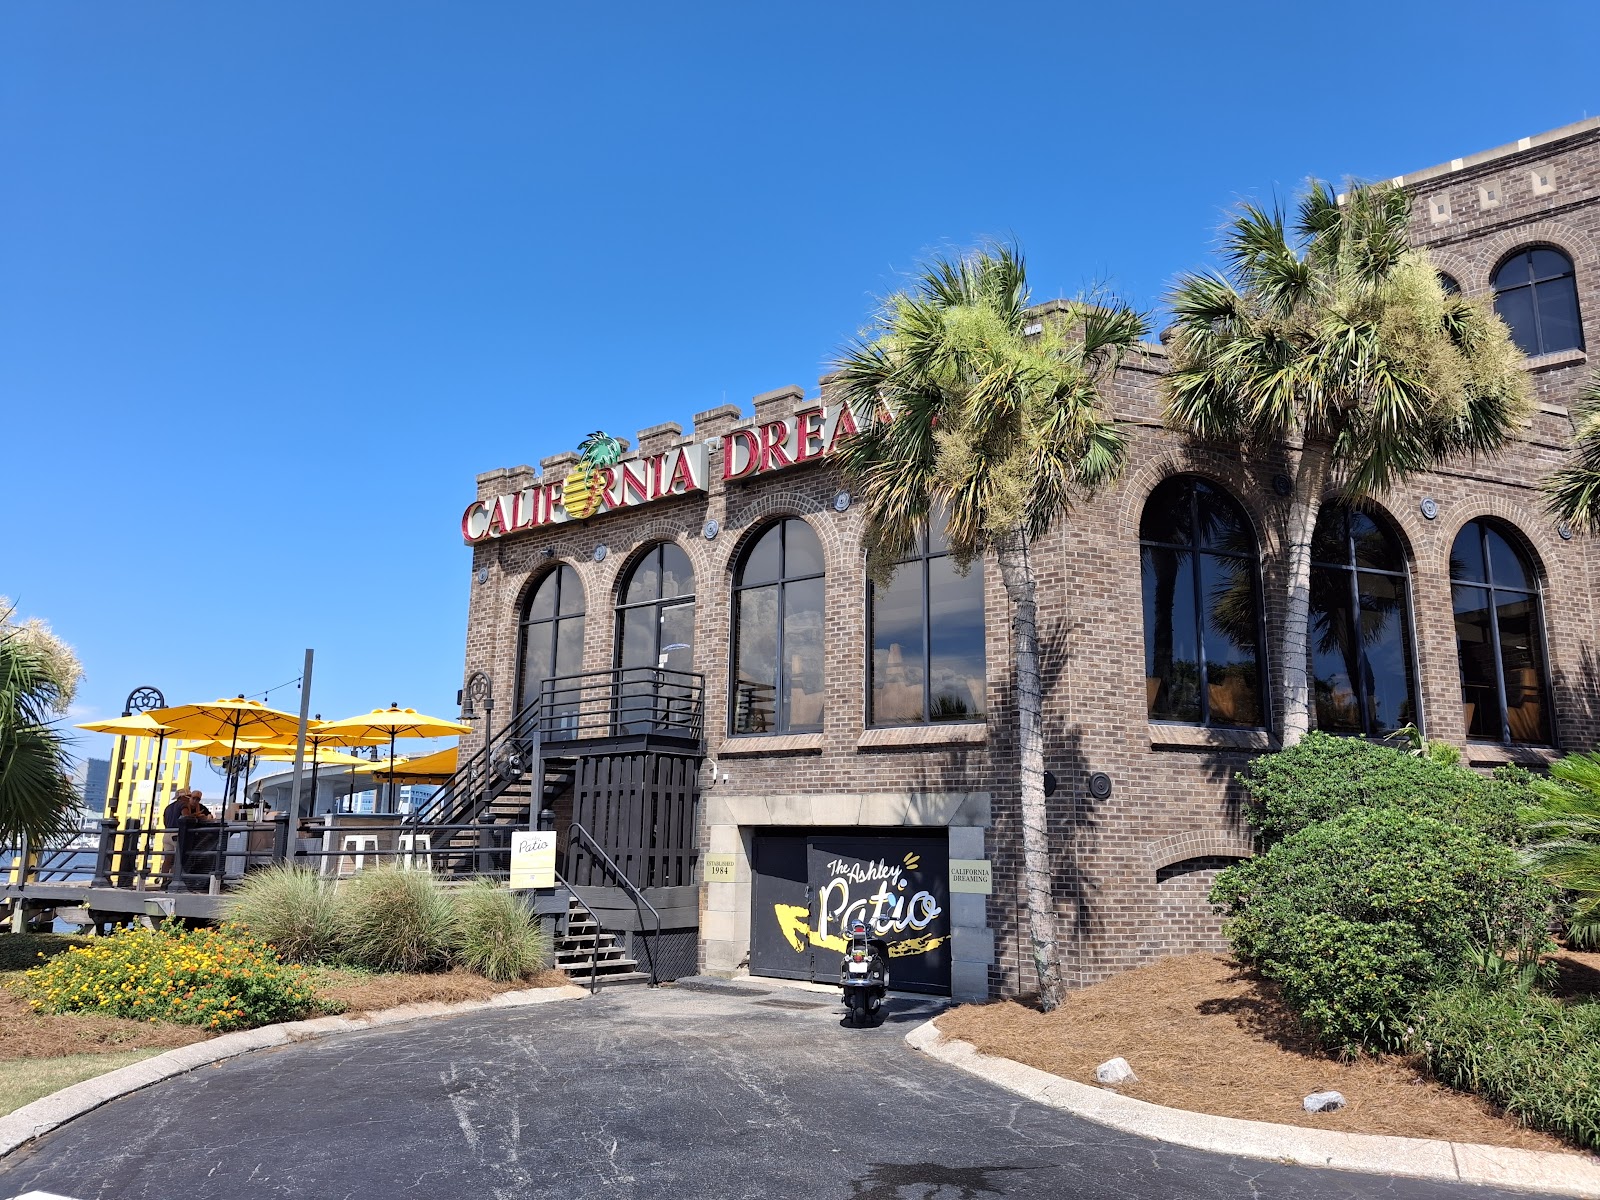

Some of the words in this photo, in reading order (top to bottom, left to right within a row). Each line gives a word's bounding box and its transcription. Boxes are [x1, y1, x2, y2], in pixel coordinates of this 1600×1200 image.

[519, 839, 549, 853] Patio
[711, 866, 728, 875] 1984
[827, 858, 850, 877] The
[846, 857, 902, 886] Ashley
[951, 868, 990, 876] CALIFORNIA
[953, 874, 988, 883] DREAMING
[818, 878, 942, 942] Patio
